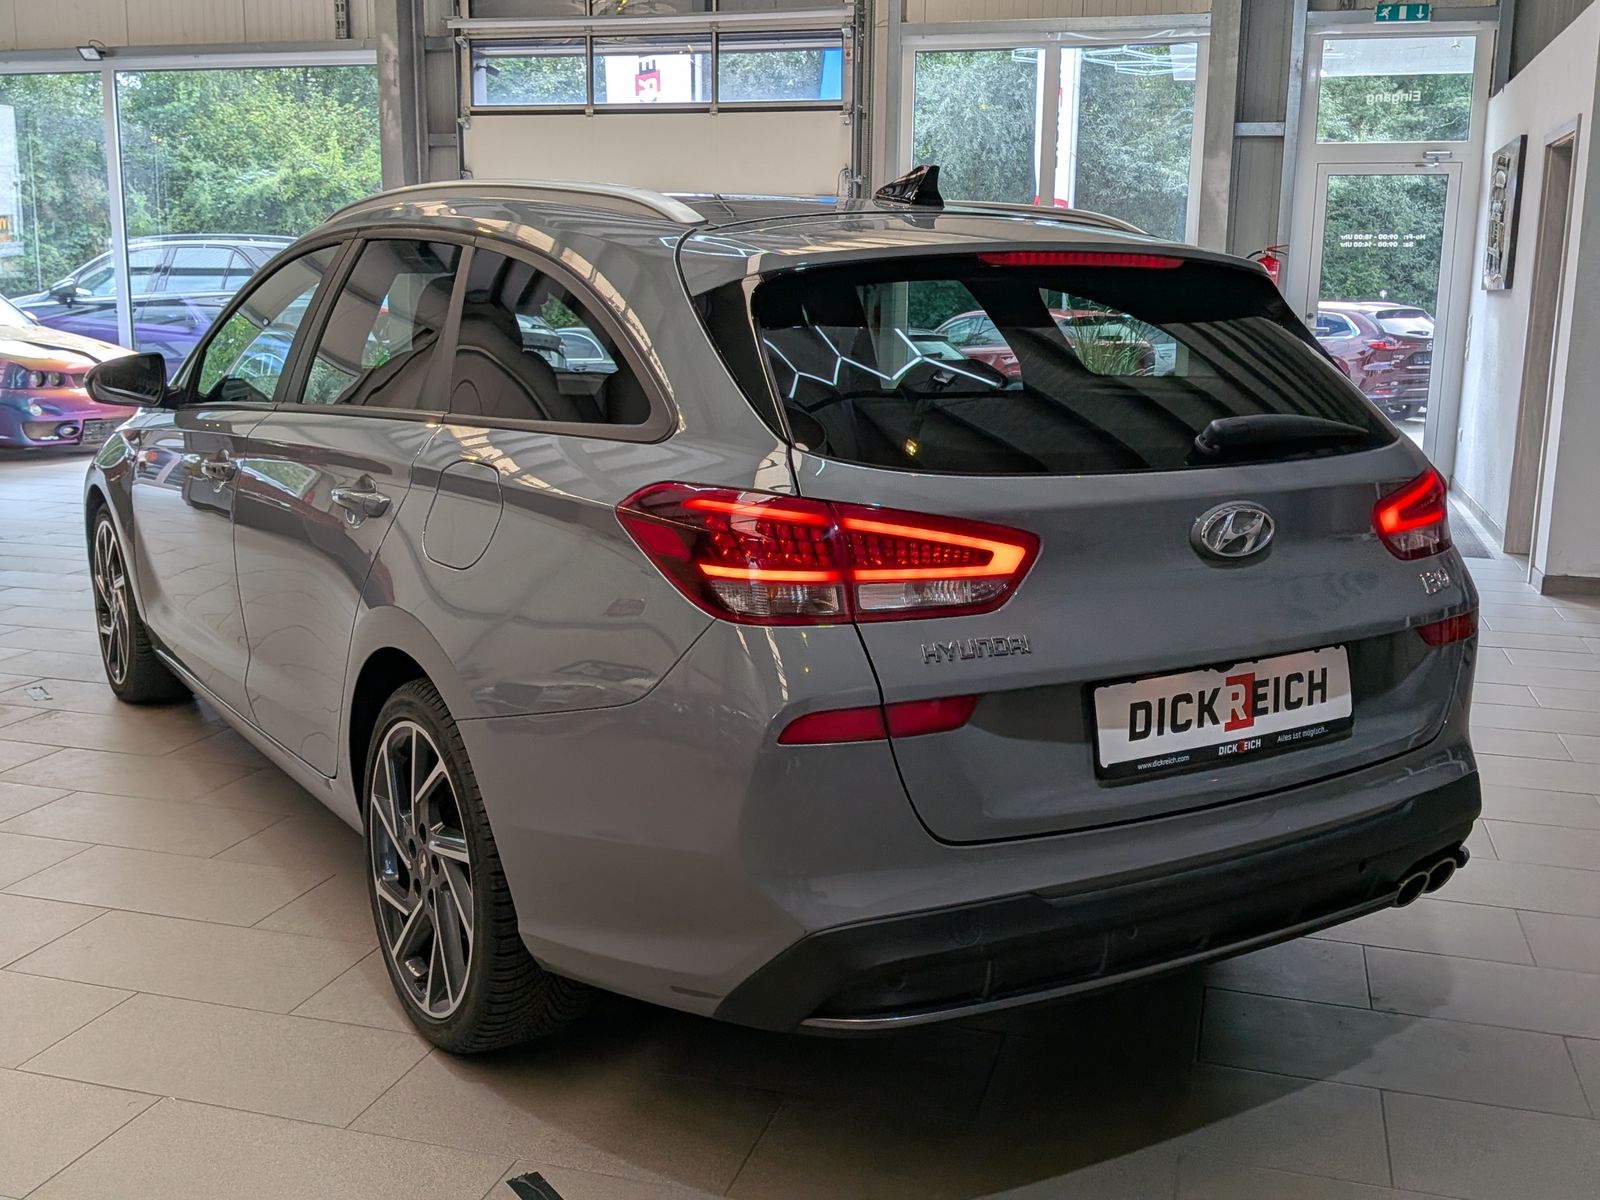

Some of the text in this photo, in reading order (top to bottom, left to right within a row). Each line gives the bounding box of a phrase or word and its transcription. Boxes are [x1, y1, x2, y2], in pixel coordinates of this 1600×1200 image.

[921, 634, 1033, 664] HYUNDAI
[1128, 667, 1328, 742] DICKREICH
[1277, 735, 1292, 743] Alles
[1293, 732, 1302, 740] ist
[1218, 739, 1261, 755] DICKEICH
[1137, 755, 1190, 770] www.dickreich.com
